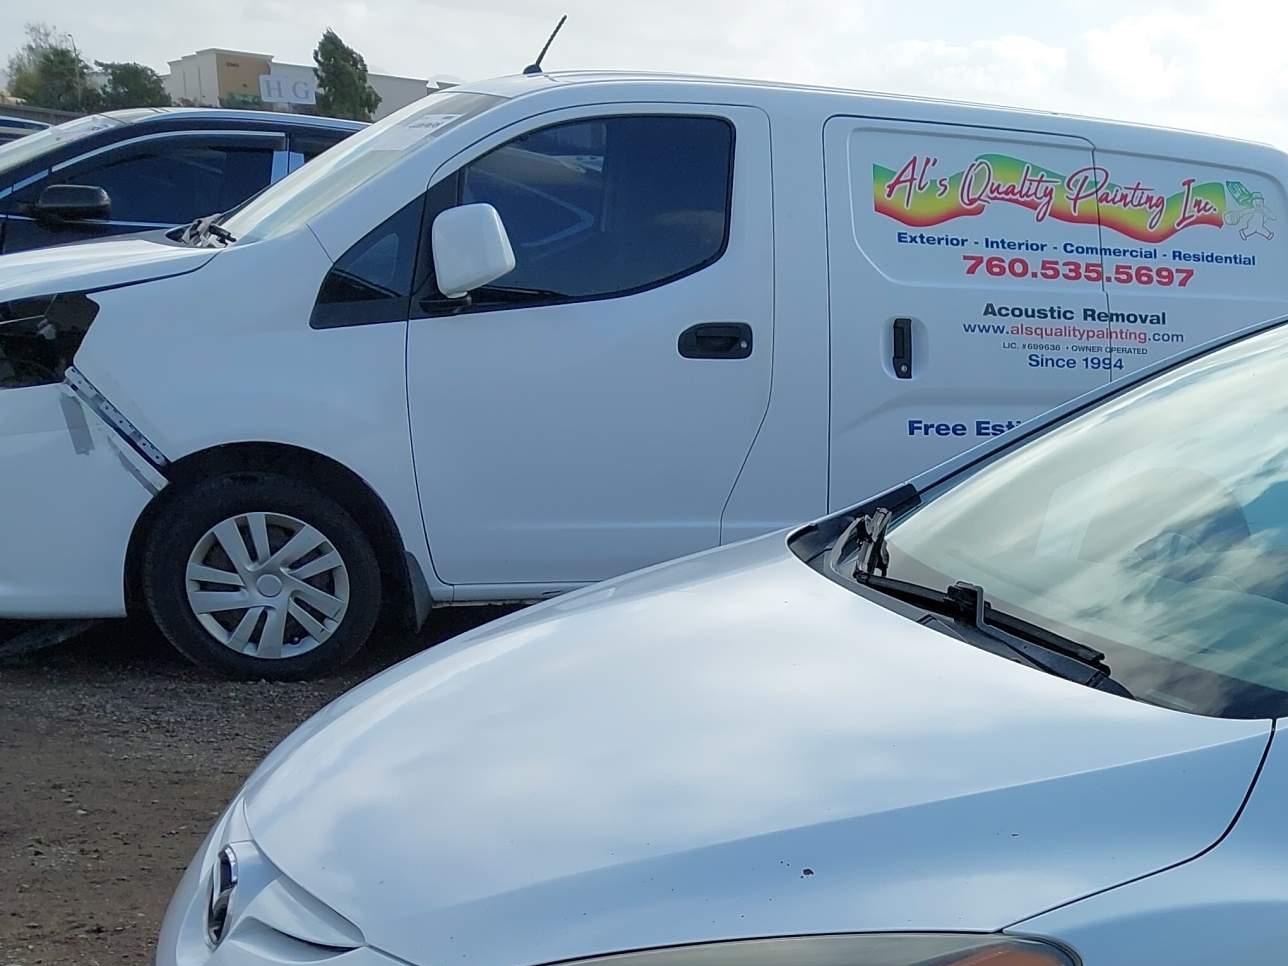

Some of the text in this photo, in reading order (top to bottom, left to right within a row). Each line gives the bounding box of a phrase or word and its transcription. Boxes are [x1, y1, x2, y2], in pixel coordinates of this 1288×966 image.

[886, 156, 1217, 230] Al's Quality Painting Inc.
[897, 231, 968, 247] Exterior
[985, 237, 1047, 252] Interior
[1063, 242, 1157, 260] Commercial
[1172, 250, 1256, 266] Residential
[962, 255, 1195, 288] 760.535.5697
[983, 303, 1167, 325] Acoustic Removal
[963, 323, 1184, 344] www.alsqualitypainting.com
[1071, 345, 1103, 353] OWNER
[1105, 346, 1148, 355] OPERATED
[1028, 353, 1124, 371] Since 1994
[908, 419, 967, 436] Free
